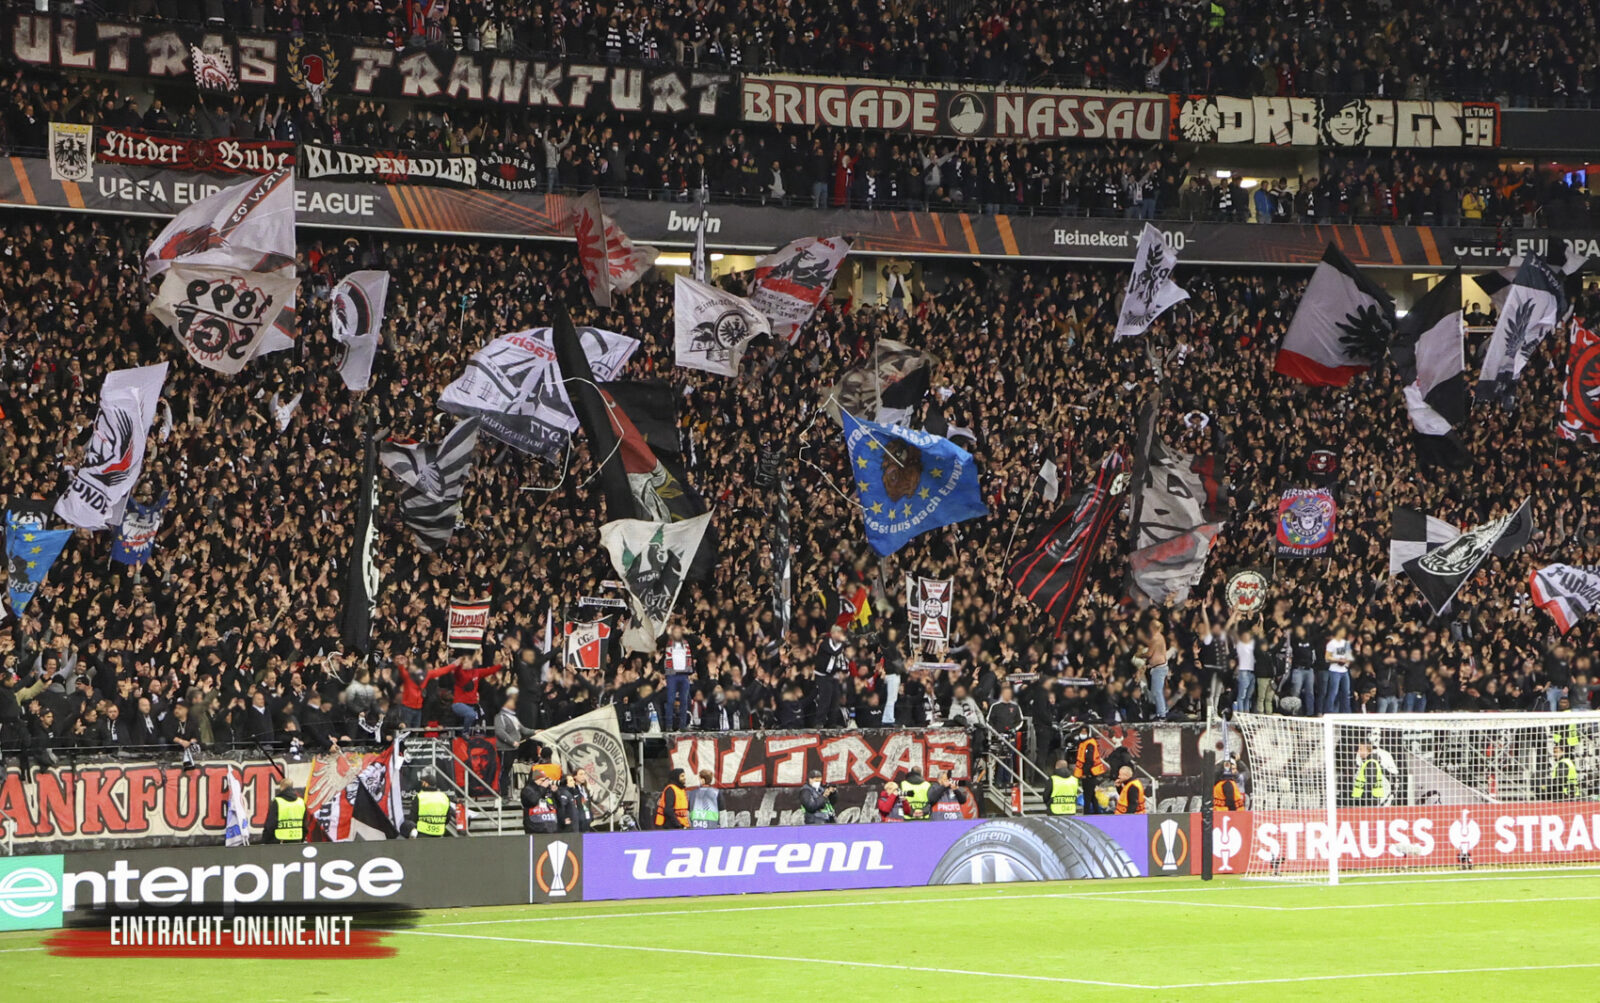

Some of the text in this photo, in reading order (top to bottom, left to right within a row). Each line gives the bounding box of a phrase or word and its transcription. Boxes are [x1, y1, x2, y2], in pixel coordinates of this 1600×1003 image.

[351, 48, 731, 116] FRANKFURT
[743, 82, 1165, 140] BRIGADE NASSAU
[1465, 107, 1494, 117] ULTRAS
[105, 130, 184, 165] Nieder
[1466, 118, 1494, 147] 99
[304, 145, 477, 186] KLIPPENADLER
[100, 177, 167, 203] UEFA
[295, 191, 374, 216] EAGUE
[1053, 229, 1128, 247] Heineken
[592, 732, 623, 766] BINDING
[670, 731, 970, 788] ULTRAS
[695, 811, 707, 819] TV
[937, 803, 961, 811] PHOTO
[964, 831, 1012, 846] Laufenn
[1257, 818, 1435, 861] STRAUSS
[632, 842, 893, 881] Laufenn
[0, 846, 405, 918] enterprise
